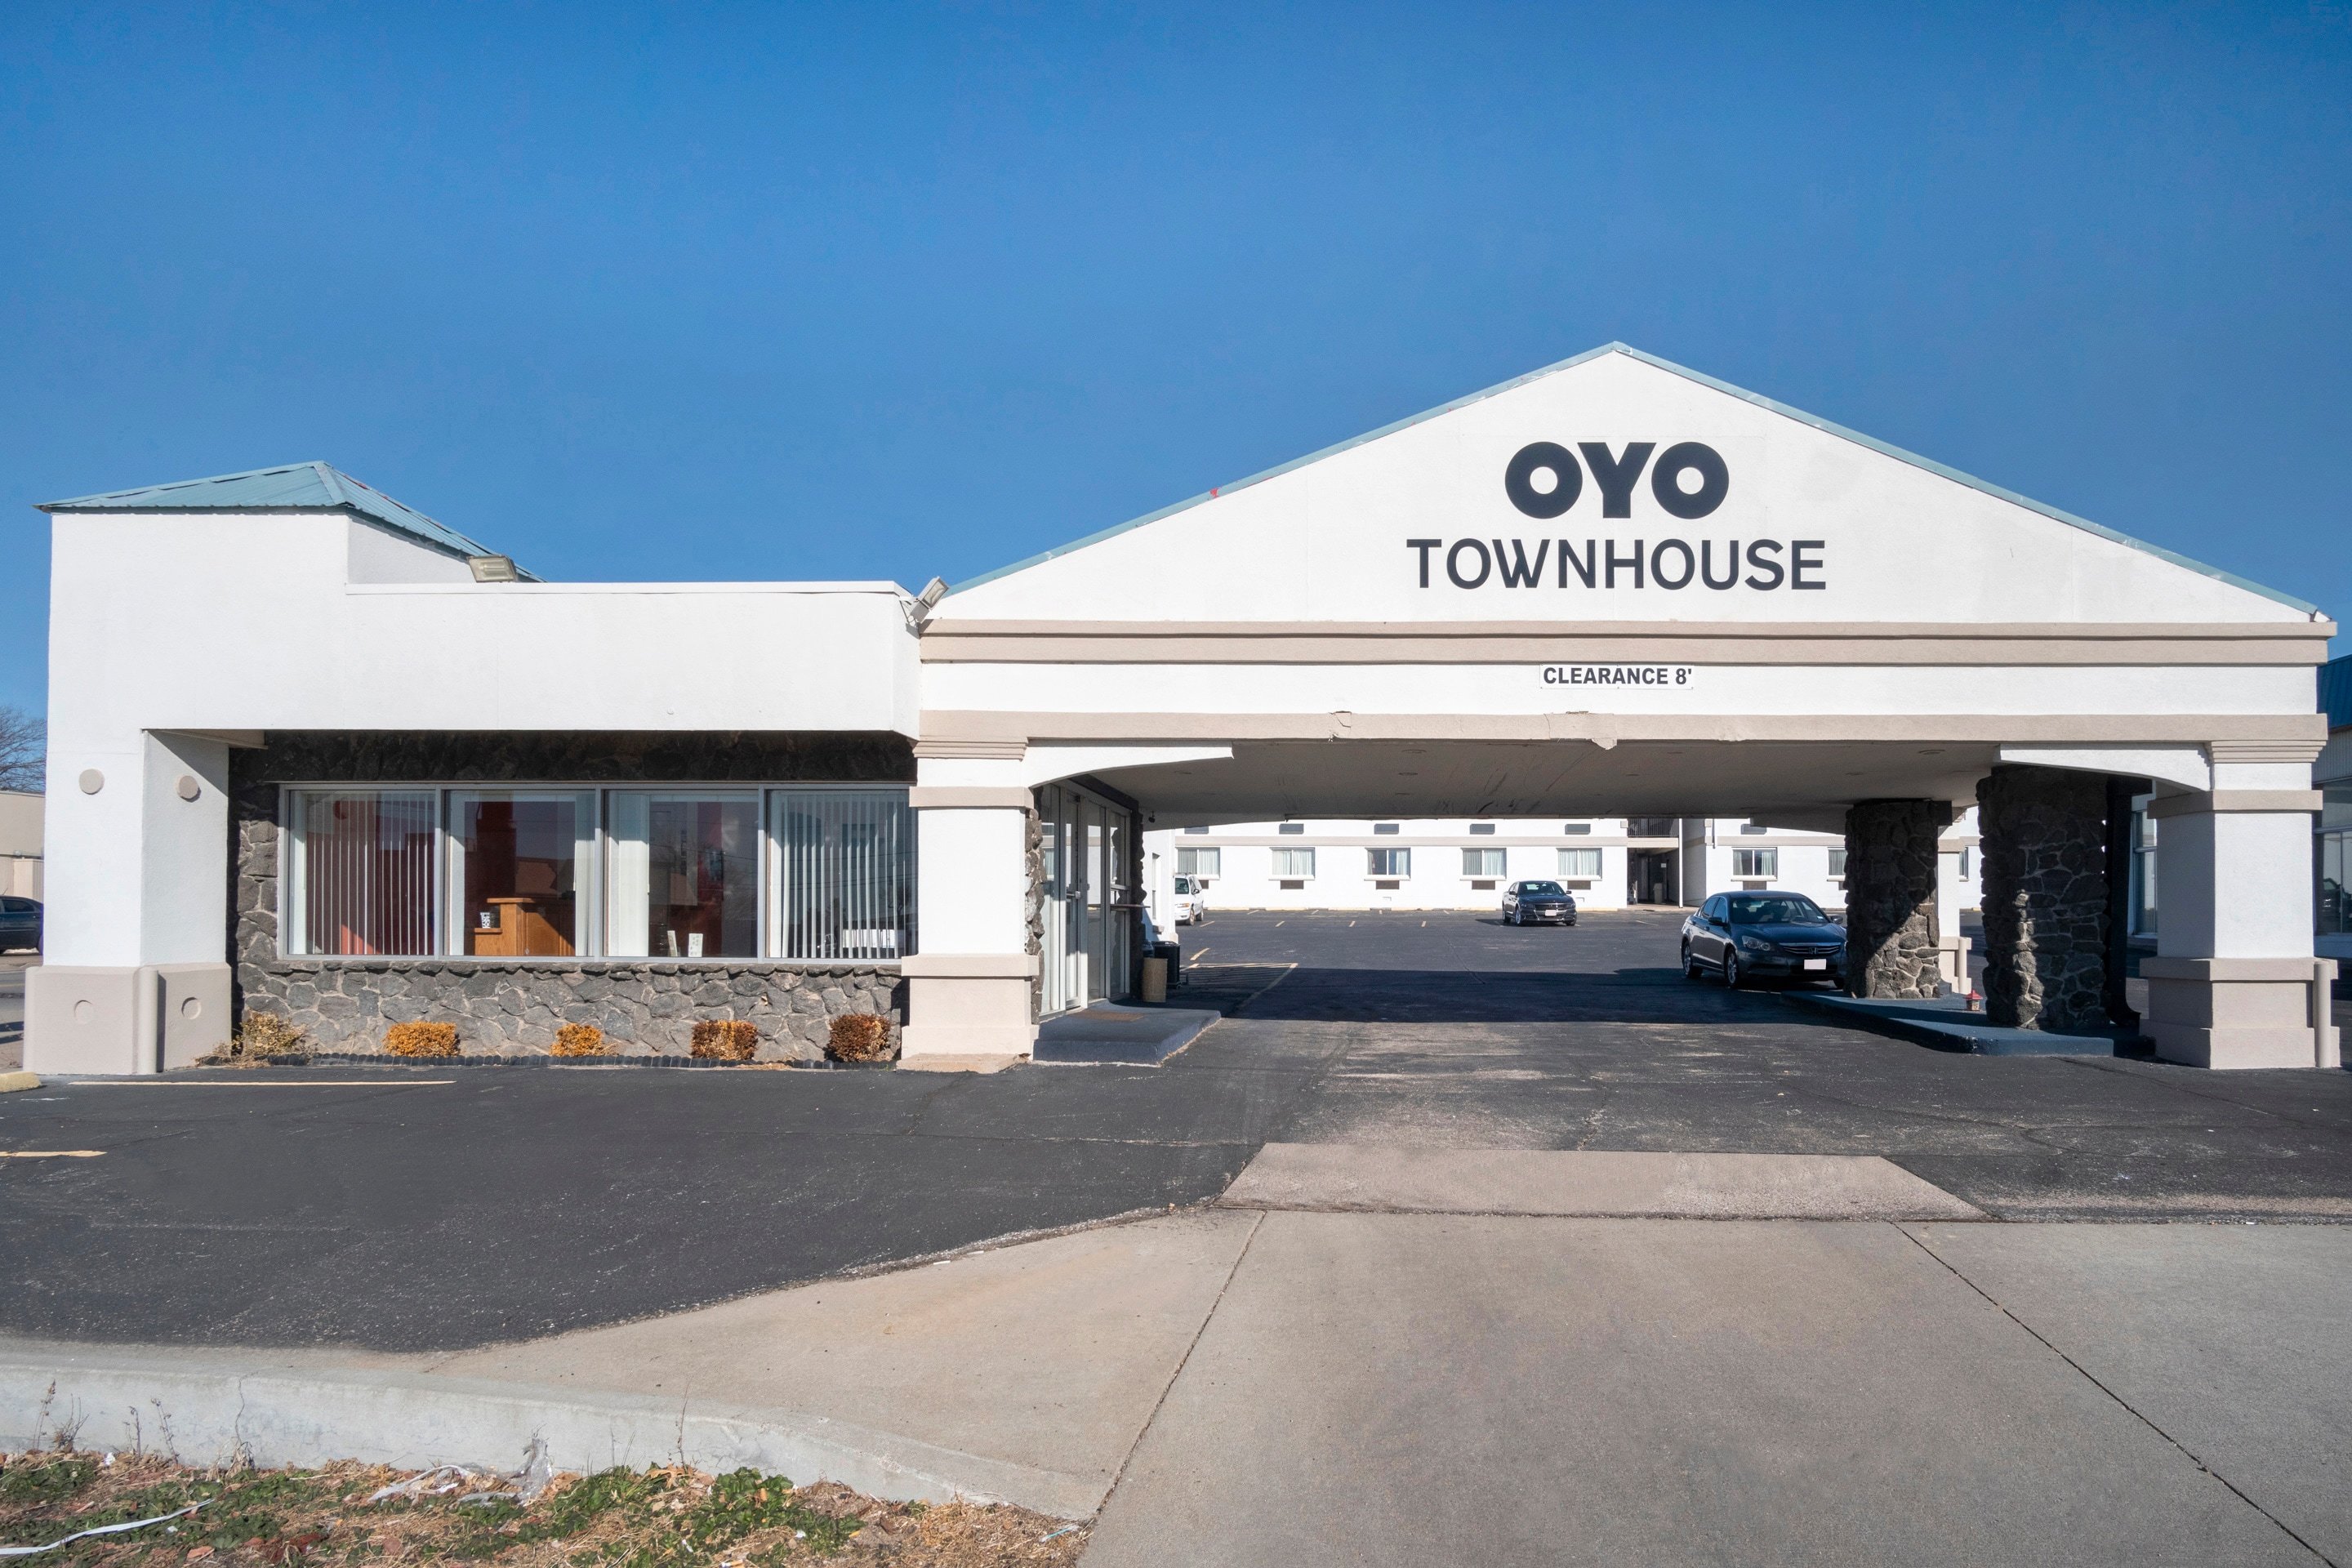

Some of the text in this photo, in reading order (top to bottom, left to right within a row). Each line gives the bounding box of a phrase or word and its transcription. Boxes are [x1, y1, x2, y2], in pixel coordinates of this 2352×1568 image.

[1504, 441, 1730, 520] OYO
[1406, 537, 1826, 591] TOWNHOUSE
[1544, 667, 1692, 685] CLEARANCE 8'
